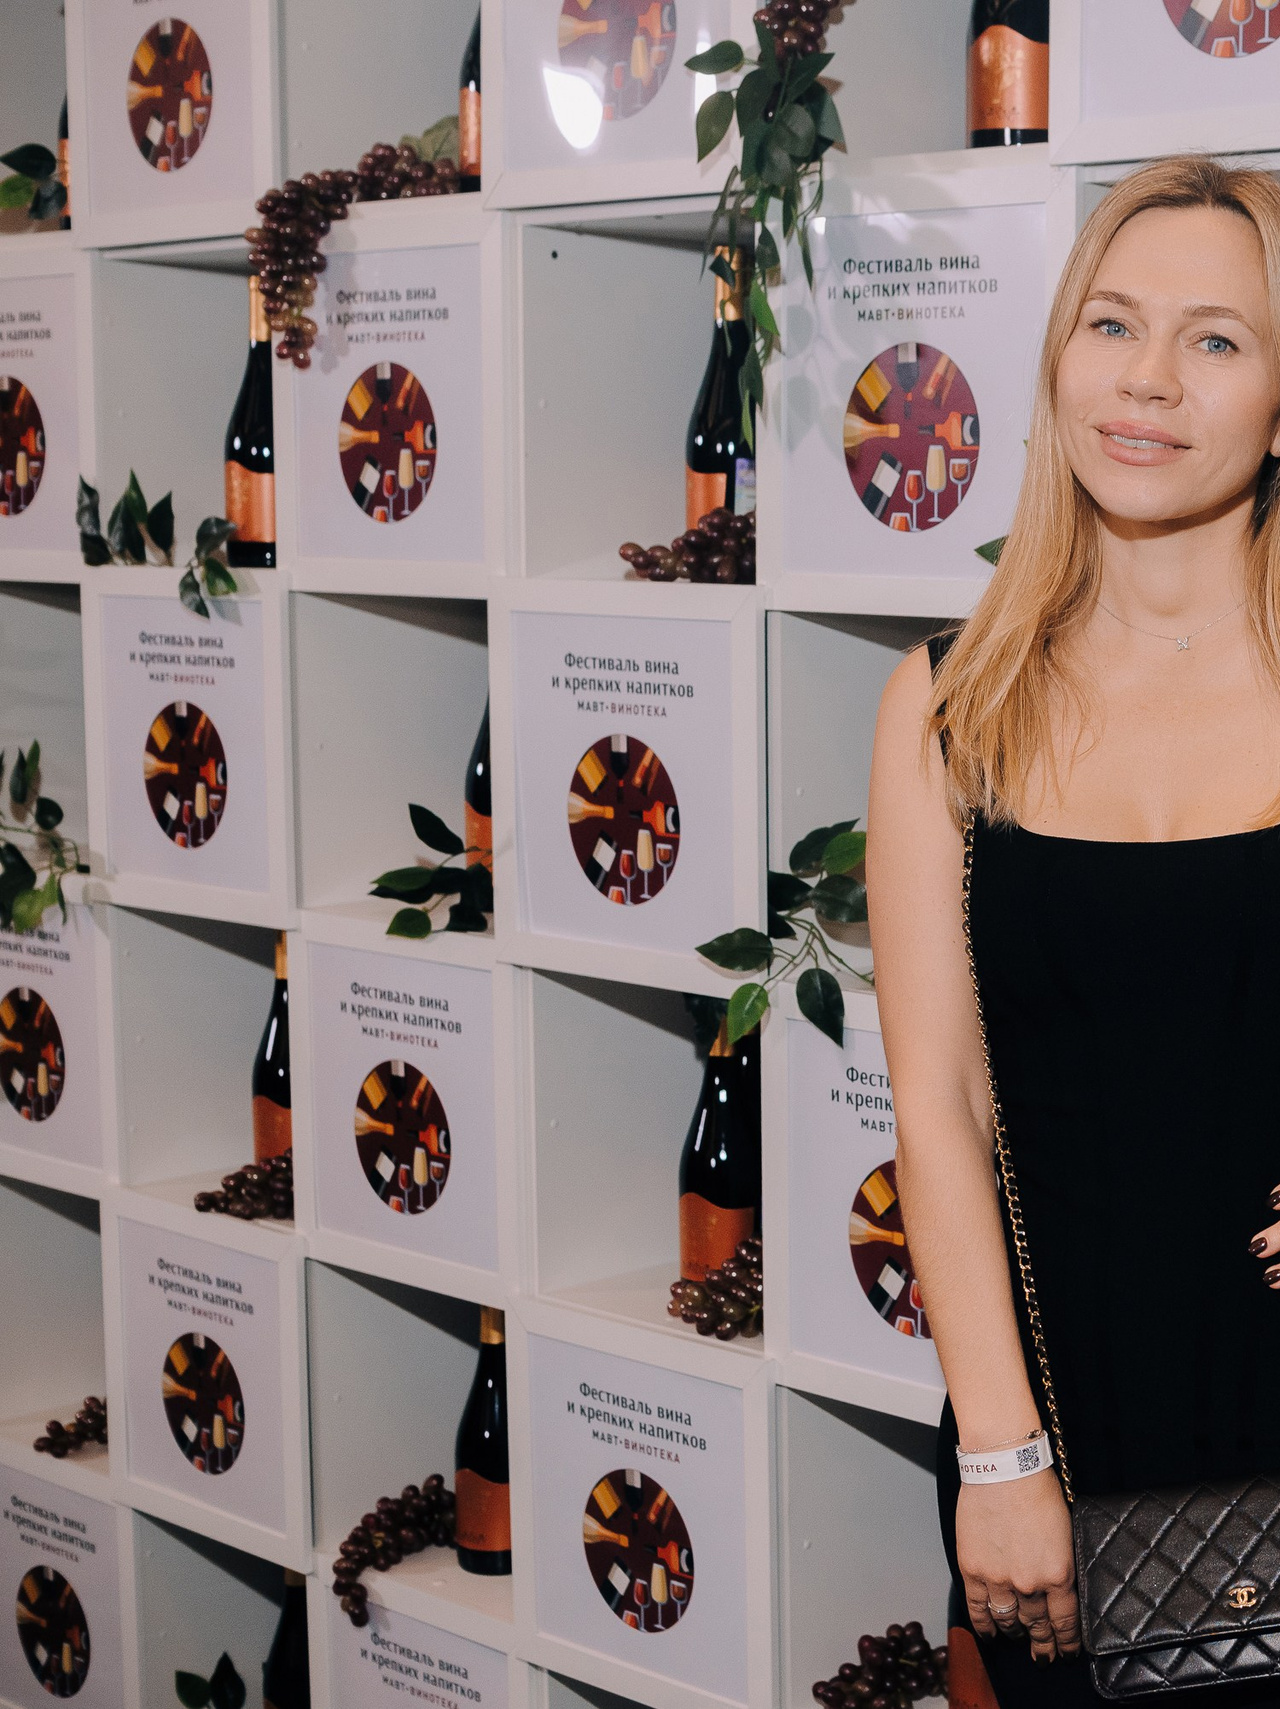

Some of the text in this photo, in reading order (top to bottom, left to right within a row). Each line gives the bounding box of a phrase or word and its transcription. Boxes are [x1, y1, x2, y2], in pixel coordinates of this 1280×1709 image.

[843, 255, 980, 274] Фестиваль вина
[828, 279, 998, 304] и крепких напитков
[564, 652, 680, 675] Фестиваль вина
[551, 675, 695, 698] и крепких напитков
[350, 981, 450, 1012] Фестиваль вина
[340, 1001, 462, 1034] и крепких напитков
[831, 1088, 893, 1112] и крепк
[579, 1382, 692, 1427] Фестиваль вина
[567, 1400, 707, 1451] и крепких напитков
[371, 1632, 468, 1680] Фестиваль вина
[360, 1647, 481, 1703] и крепких напитков
